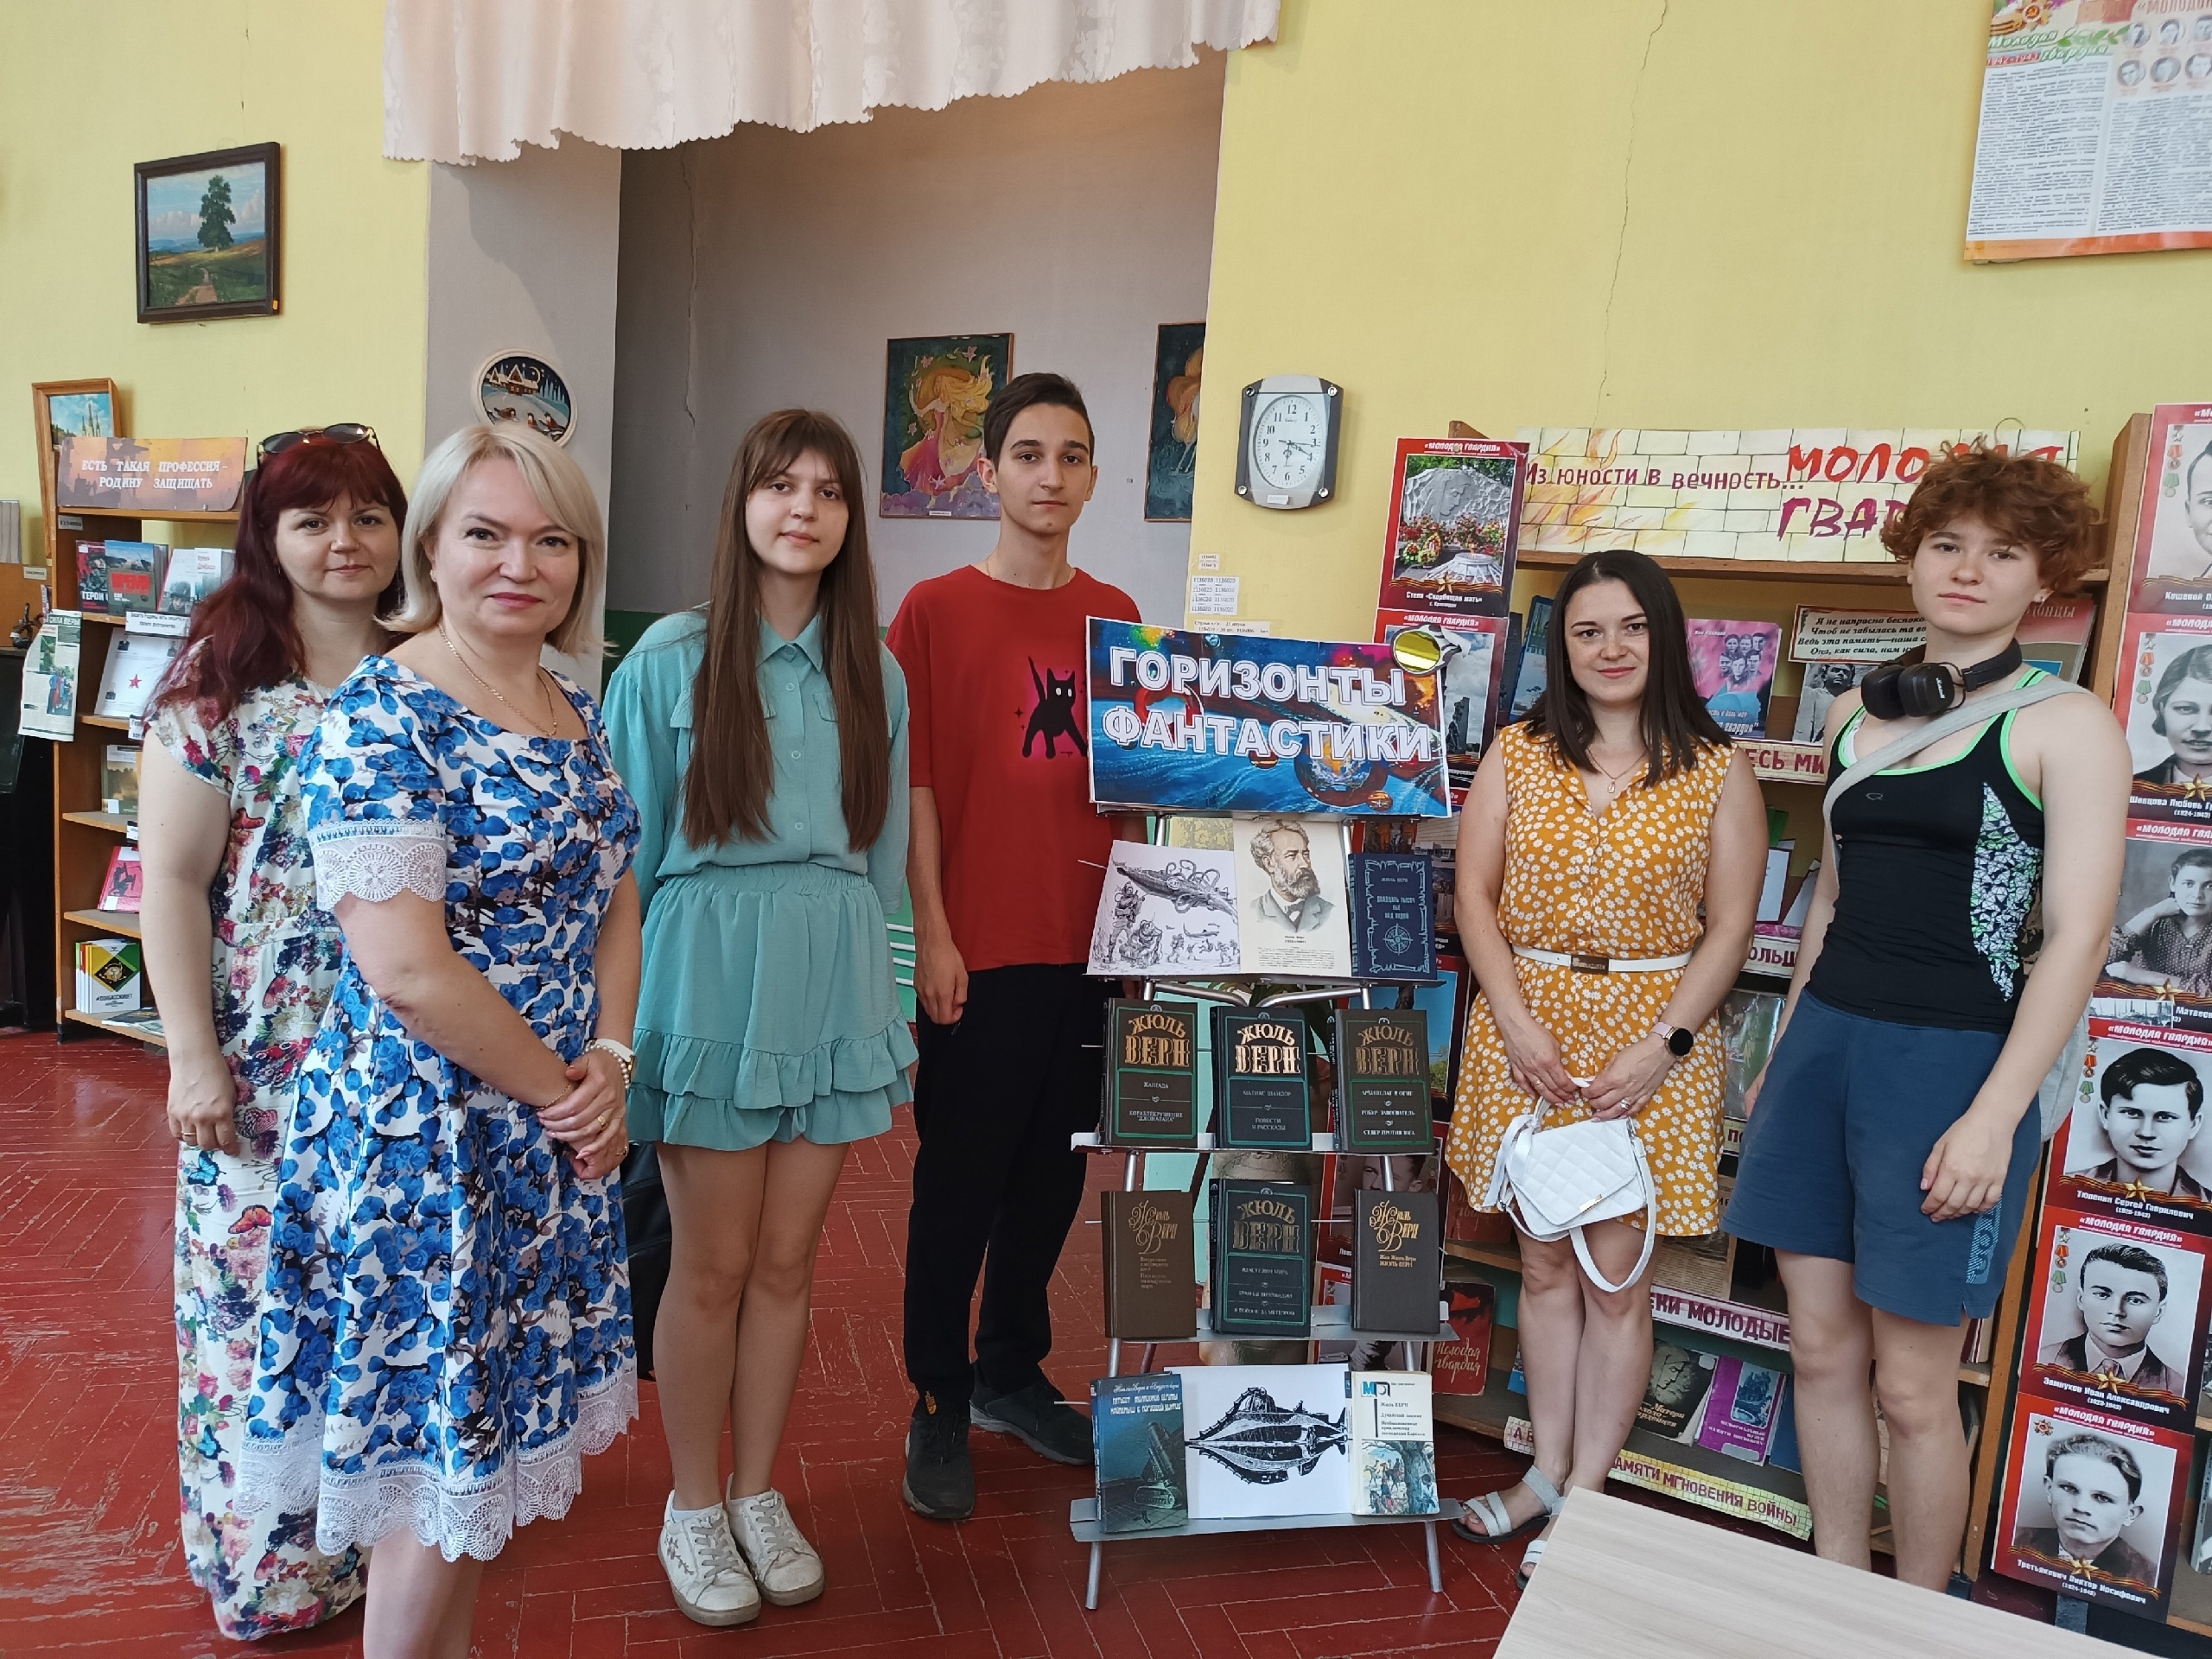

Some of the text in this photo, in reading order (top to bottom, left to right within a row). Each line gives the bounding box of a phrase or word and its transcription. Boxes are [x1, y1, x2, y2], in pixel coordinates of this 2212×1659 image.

[1987, 30, 2059, 48] Молодая
[2040, 46, 2109, 64] гвардия
[1274, 412, 1282, 423] 11
[1287, 404, 1297, 415] 12
[1305, 412, 1309, 422] 1
[1267, 425, 1275, 435] 10
[1310, 425, 1316, 434] 2
[1263, 438, 1269, 447] 9
[1311, 438, 1317, 448] 3
[1464, 443, 1501, 454] ГВАРДИЯ»
[1264, 453, 1270, 461] 8
[1307, 453, 1313, 461] 4
[82, 460, 221, 473] ЕСТЬ ТАКАЯ ПРОФЕССИЯ
[1272, 465, 1277, 474] 7
[1299, 465, 1306, 474] 5
[1525, 462, 1547, 486] Из
[1556, 467, 1638, 486] юности
[99, 477, 213, 491] РОДИНУ ЗАЩИЩАТЬ
[1284, 472, 1290, 480] 6
[2164, 591, 2202, 601] Кошевой
[1403, 614, 1479, 627] «МОЛОДАЯ ГВАРДИЯ»
[1839, 618, 1885, 626] напрасно
[1811, 626, 1837, 635] Чтоб
[1797, 637, 1820, 645] Ведь
[1109, 645, 1407, 707] ГОРИЗОНТЫ
[1101, 705, 1433, 763] ФАНТАСТИКИ
[2129, 795, 2168, 806] Шевцова
[2170, 798, 2202, 810] Любовь
[2136, 824, 2190, 837] «МОЛОДАЯ
[1128, 1014, 1186, 1039] ЖЮЛЬ
[1236, 1023, 1295, 1046] ЖЮЛЬ
[1357, 1025, 1414, 1047] ЖЮЛЬ
[2107, 1025, 2212, 1046] «МОЛОДАЯ ГВАРДИЯ»
[1124, 1035, 1191, 1068] ВЕРН
[1235, 1045, 1301, 1074] ВЕРН
[1355, 1046, 1420, 1076] ВЕРН
[1236, 1199, 1295, 1224] ЖЮЛЬ
[2076, 1189, 2194, 1220] Тюленин Сергей Гаврилович
[1232, 1219, 1300, 1253] ВЕРН
[2079, 1216, 2183, 1243] «МОЛОДАЯ ГВАРДИЯ»
[1687, 1300, 1790, 1344] МОЛОДЫЕ
[1434, 1355, 1481, 1384] гвардия
[2084, 1386, 2105, 1399] Иван
[2106, 1391, 2171, 1415] Александрович
[1651, 1402, 1686, 1419] Матери
[2053, 1406, 2155, 1437] «МОЛОДАЯ ГВАРДИЯ»
[1513, 1427, 1522, 1440] А
[1662, 1472, 1744, 1508] МГНОВЕНИЯ
[1747, 1499, 1797, 1527] ВОЙНЫ
[2016, 1558, 2146, 1605] Третьякевич Виктор Иосифович
